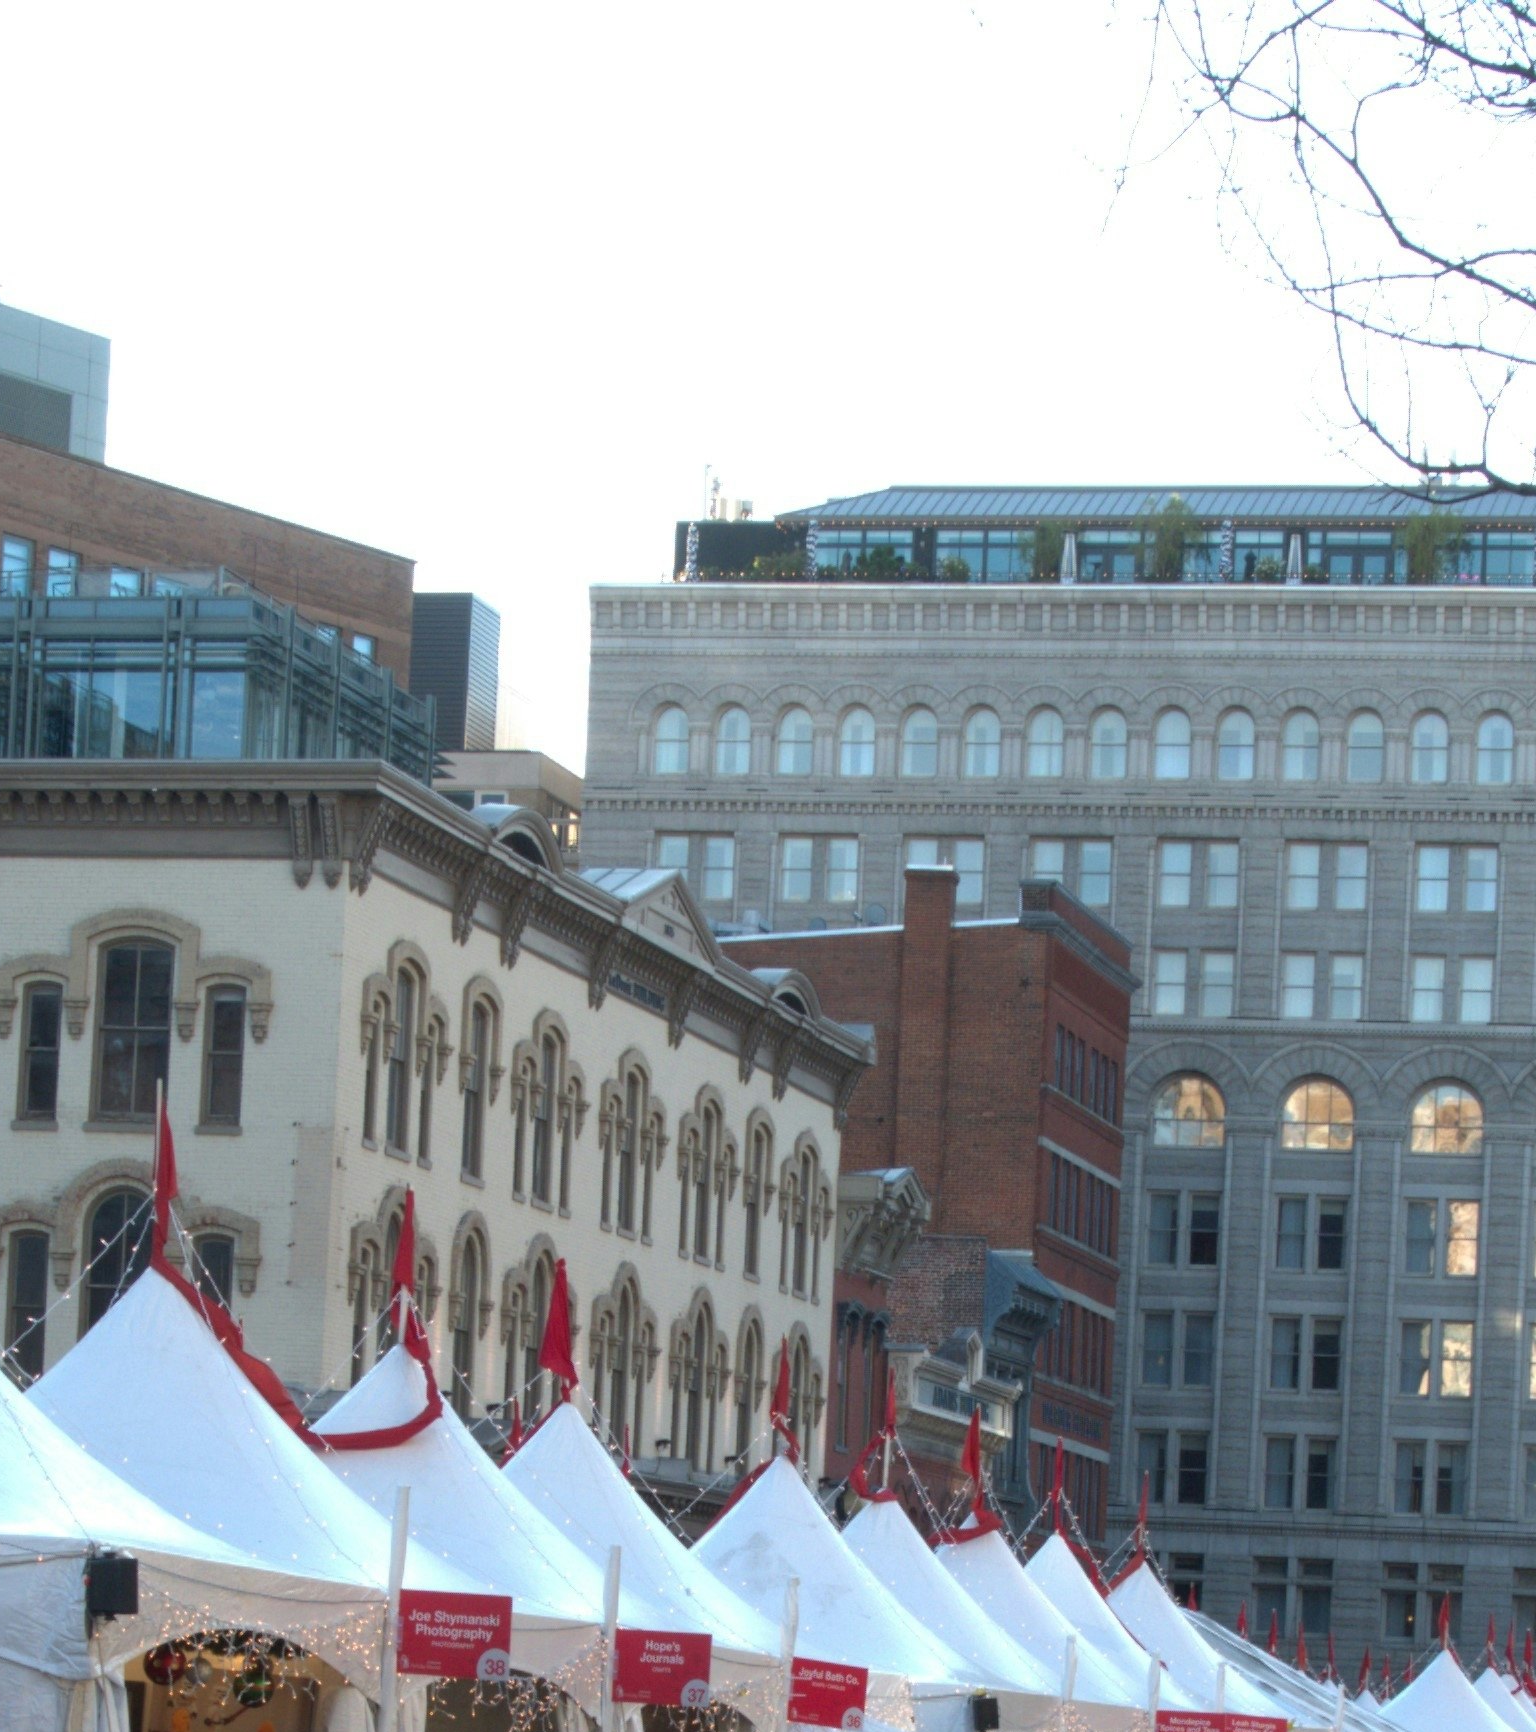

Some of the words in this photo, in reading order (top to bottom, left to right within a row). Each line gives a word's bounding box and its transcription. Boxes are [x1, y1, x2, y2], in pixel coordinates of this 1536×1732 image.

[408, 1608, 431, 1621] Joe
[433, 1609, 501, 1627] Shymanski
[415, 1622, 493, 1643] Photography
[644, 1639, 681, 1653] Hope's
[639, 1652, 685, 1665] Journals
[485, 1659, 505, 1675] 38
[799, 1666, 824, 1680] Joyful
[846, 1673, 860, 1686] Co.
[688, 1688, 705, 1703] 37
[847, 1715, 861, 1729] 36
